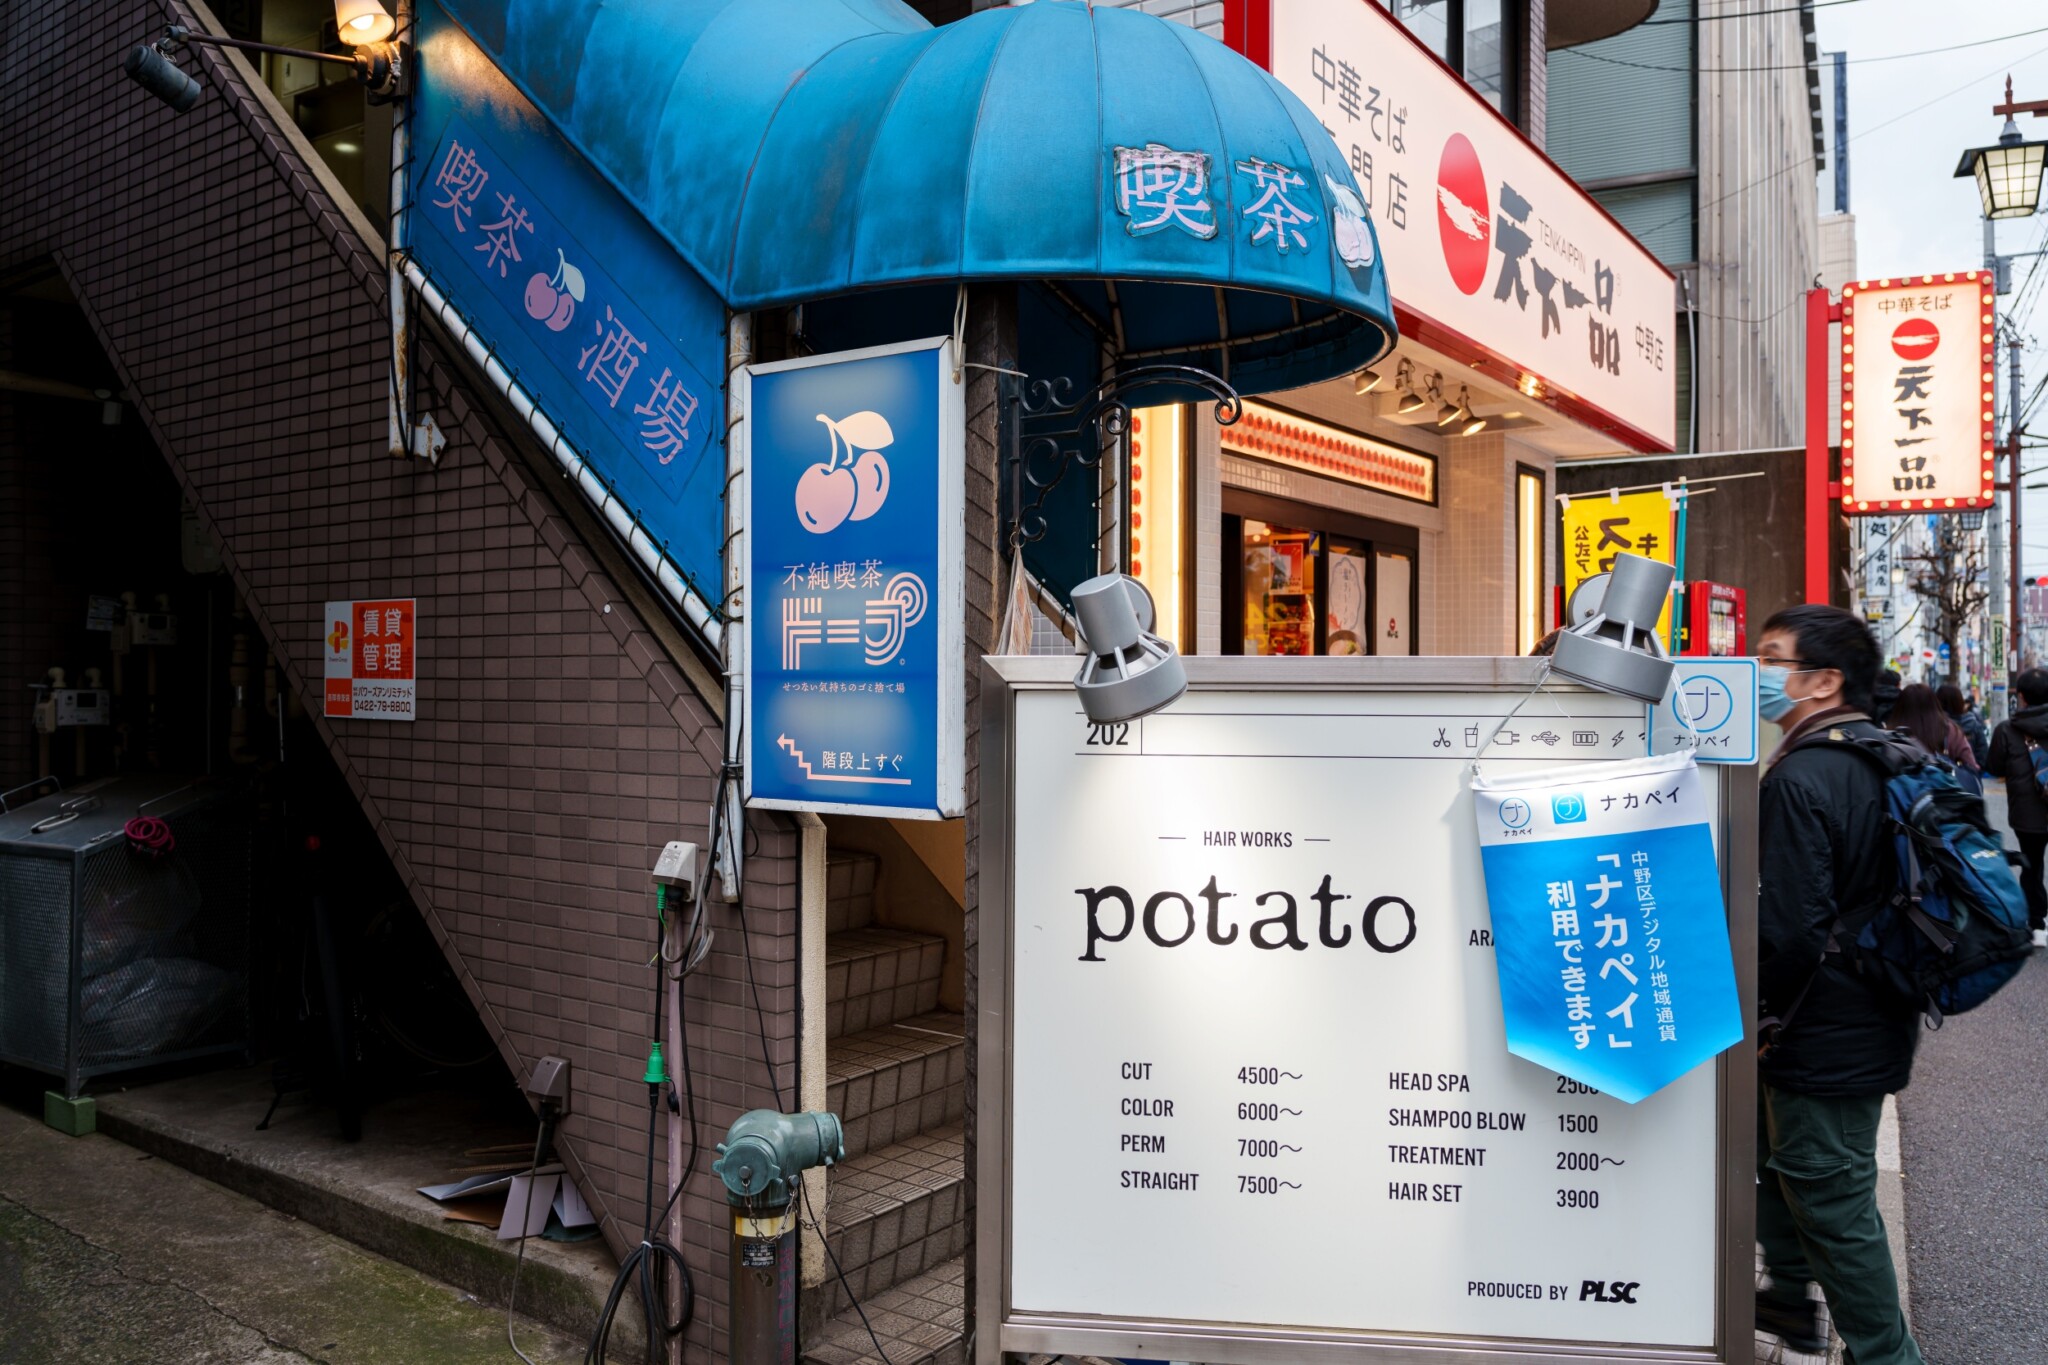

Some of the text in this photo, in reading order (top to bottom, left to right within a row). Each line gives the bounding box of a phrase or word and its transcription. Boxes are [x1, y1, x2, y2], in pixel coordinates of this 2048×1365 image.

[1312, 43, 1408, 156] 中華そば
[433, 140, 534, 278] 喫茶
[1115, 146, 1317, 251] 喫茶
[1538, 218, 1587, 275] TENKAIPPIN
[1494, 180, 1621, 376] 天下一品
[1878, 293, 1953, 314] 中華そば
[1635, 321, 1664, 373] 中野店
[577, 304, 698, 464] 酒場
[1893, 365, 1938, 492] 天下一品
[782, 559, 883, 591] 不純喫茶
[363, 608, 402, 637] 賃貸
[363, 643, 402, 671] 管理
[782, 682, 905, 694] せつない気持ちのゴミ捨て場
[354, 700, 411, 713] 0422-79-8800
[1086, 721, 1129, 746] 202
[1673, 735, 1731, 747] ナカペイ
[822, 751, 904, 772] 階段上すぐ
[1600, 786, 1680, 812] ナカペイ
[1203, 831, 1293, 848] HAIR WORKS
[1503, 827, 1533, 837] ナカペイ
[1074, 874, 1417, 962] potato
[1586, 853, 1639, 1049] 「ナカペイ」
[1631, 850, 1677, 1042] 中野区デジタル地域通貨
[1546, 880, 1596, 1050] 利用できます
[1121, 1062, 1152, 1080] CUT
[1389, 1072, 1432, 1091] HEAD
[1437, 1074, 1470, 1092] SPA
[1121, 1098, 1174, 1117] COLOR
[1388, 1108, 1599, 1133] SHAMPOO BLOW 1500
[1120, 1134, 1165, 1153] PERM
[1388, 1145, 1487, 1166] TREATMENT
[1120, 1170, 1199, 1191] STRAIGHT
[1388, 1182, 1599, 1209] HAIR SET 3900
[1467, 1280, 1641, 1304] PRODUCED BY PLSC
